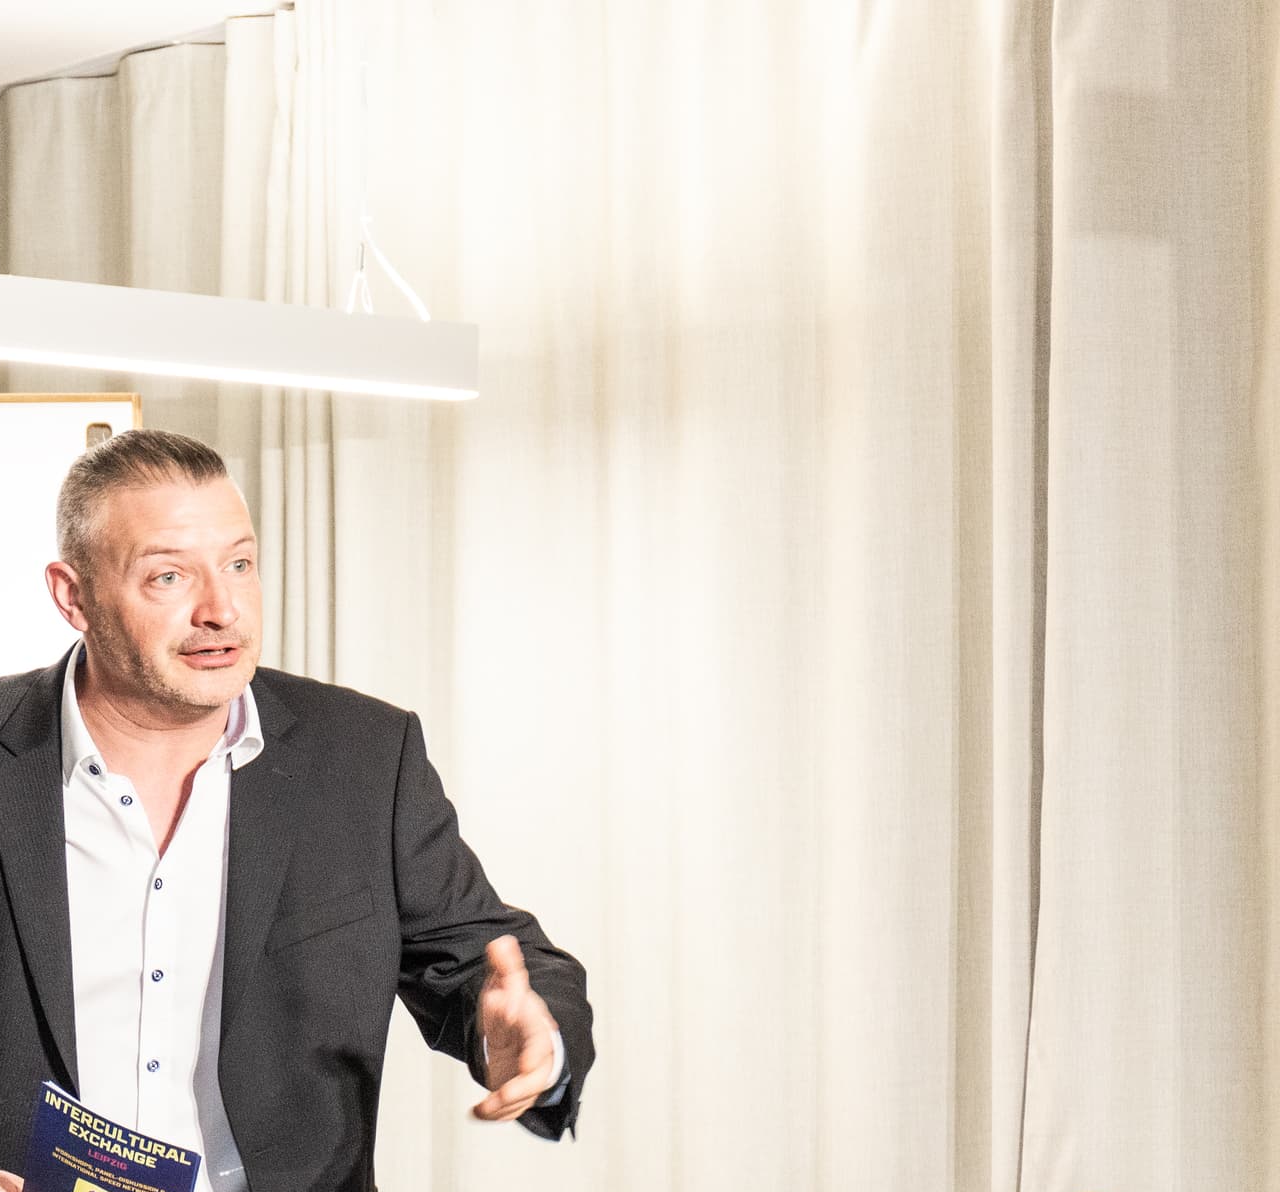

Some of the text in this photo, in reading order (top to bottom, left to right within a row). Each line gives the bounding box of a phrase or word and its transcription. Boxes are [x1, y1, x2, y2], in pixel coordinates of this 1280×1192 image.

[45, 1090, 192, 1166] INTERCULTURAL
[69, 1121, 157, 1168] EXCHANGE
[51, 1151, 98, 1179] INTERNATIONAL
[99, 1175, 122, 1188] SPEED
[88, 1148, 128, 1171] LEIPZIG
